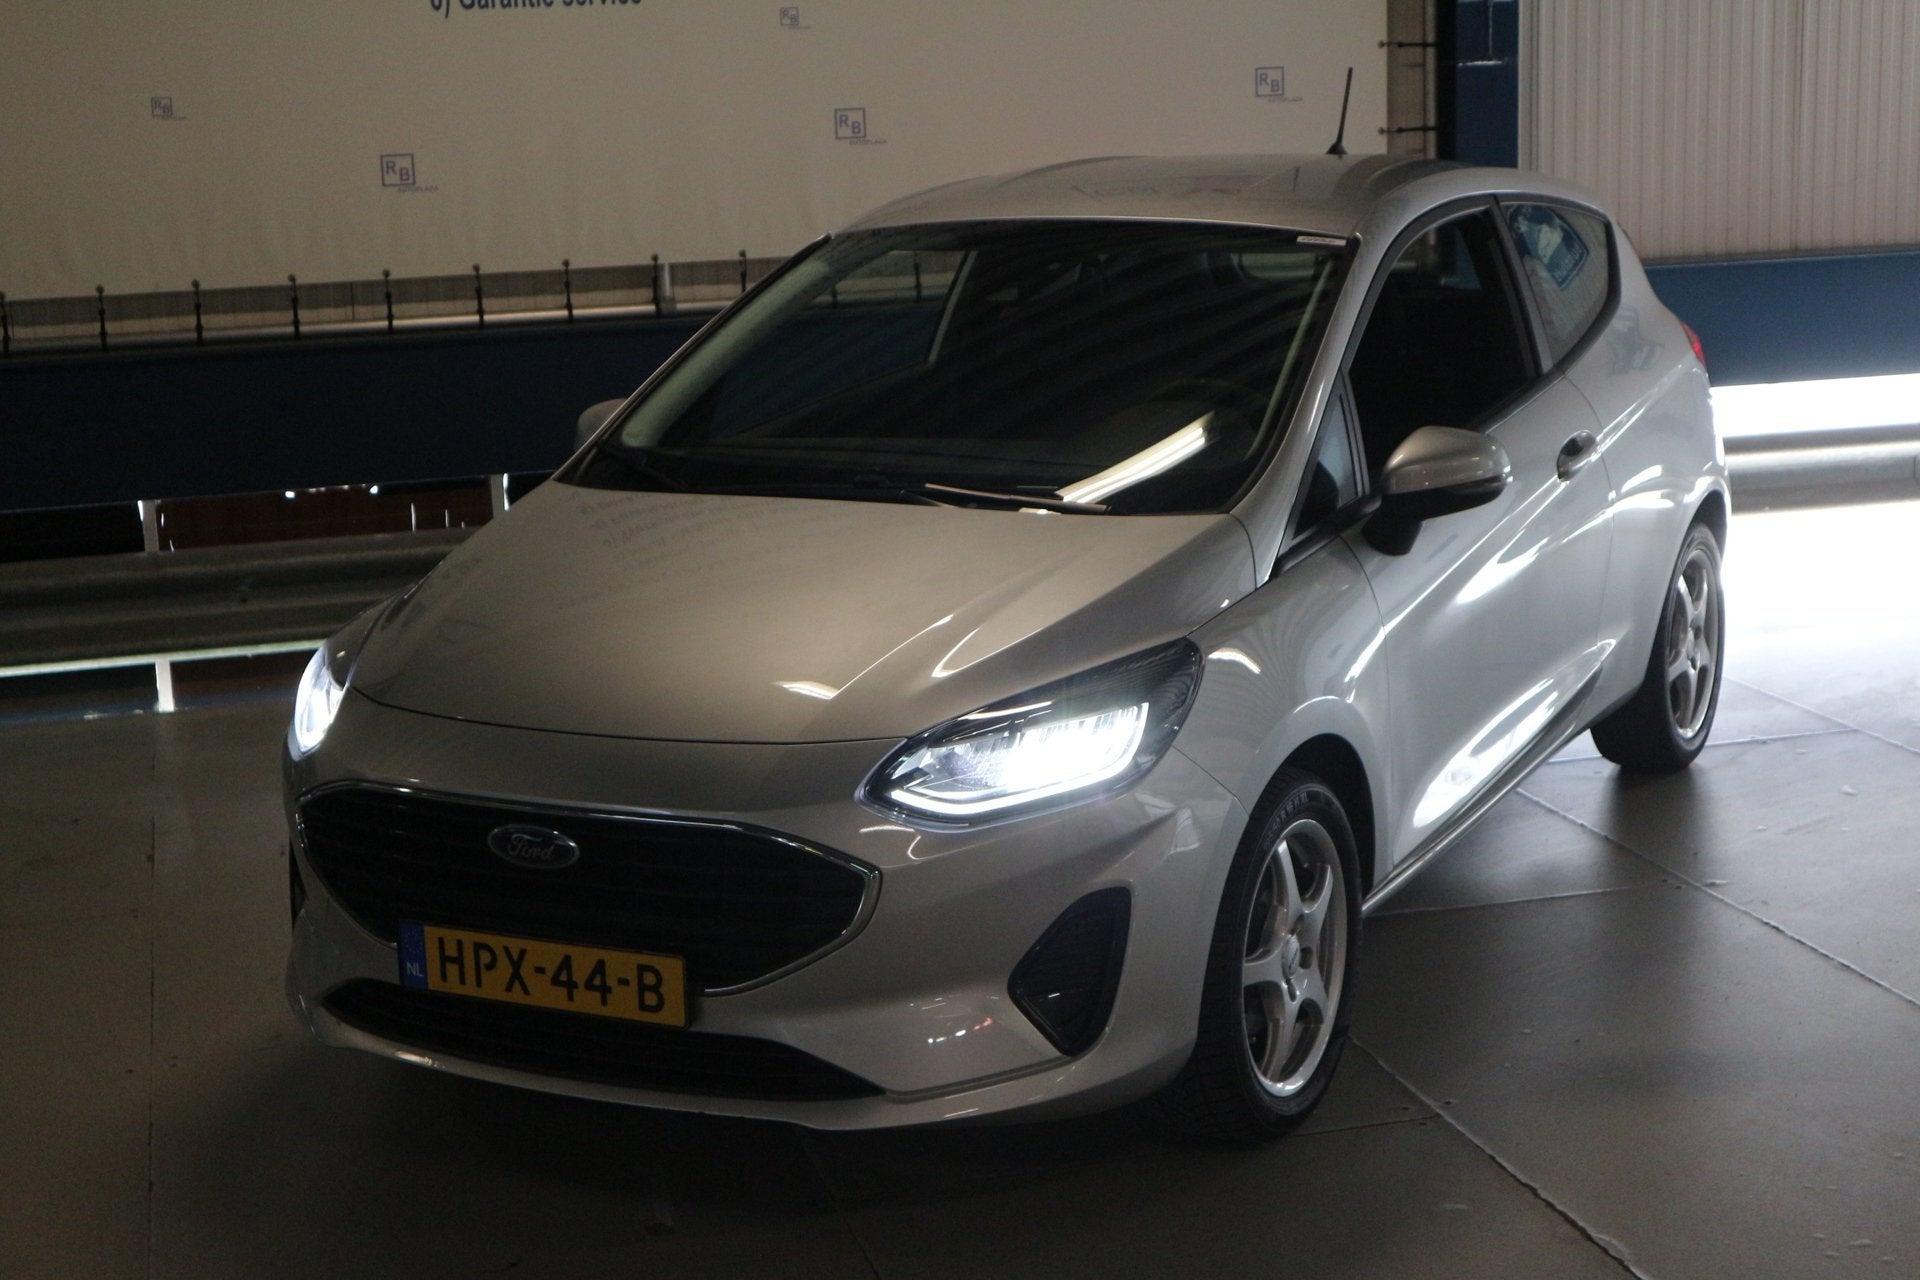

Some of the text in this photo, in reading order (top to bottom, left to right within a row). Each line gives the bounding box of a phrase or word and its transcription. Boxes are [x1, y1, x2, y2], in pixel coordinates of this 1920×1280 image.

[507, 833, 555, 861] Ford
[406, 961, 425, 977] NL
[437, 936, 666, 1014] HPX-44-B
